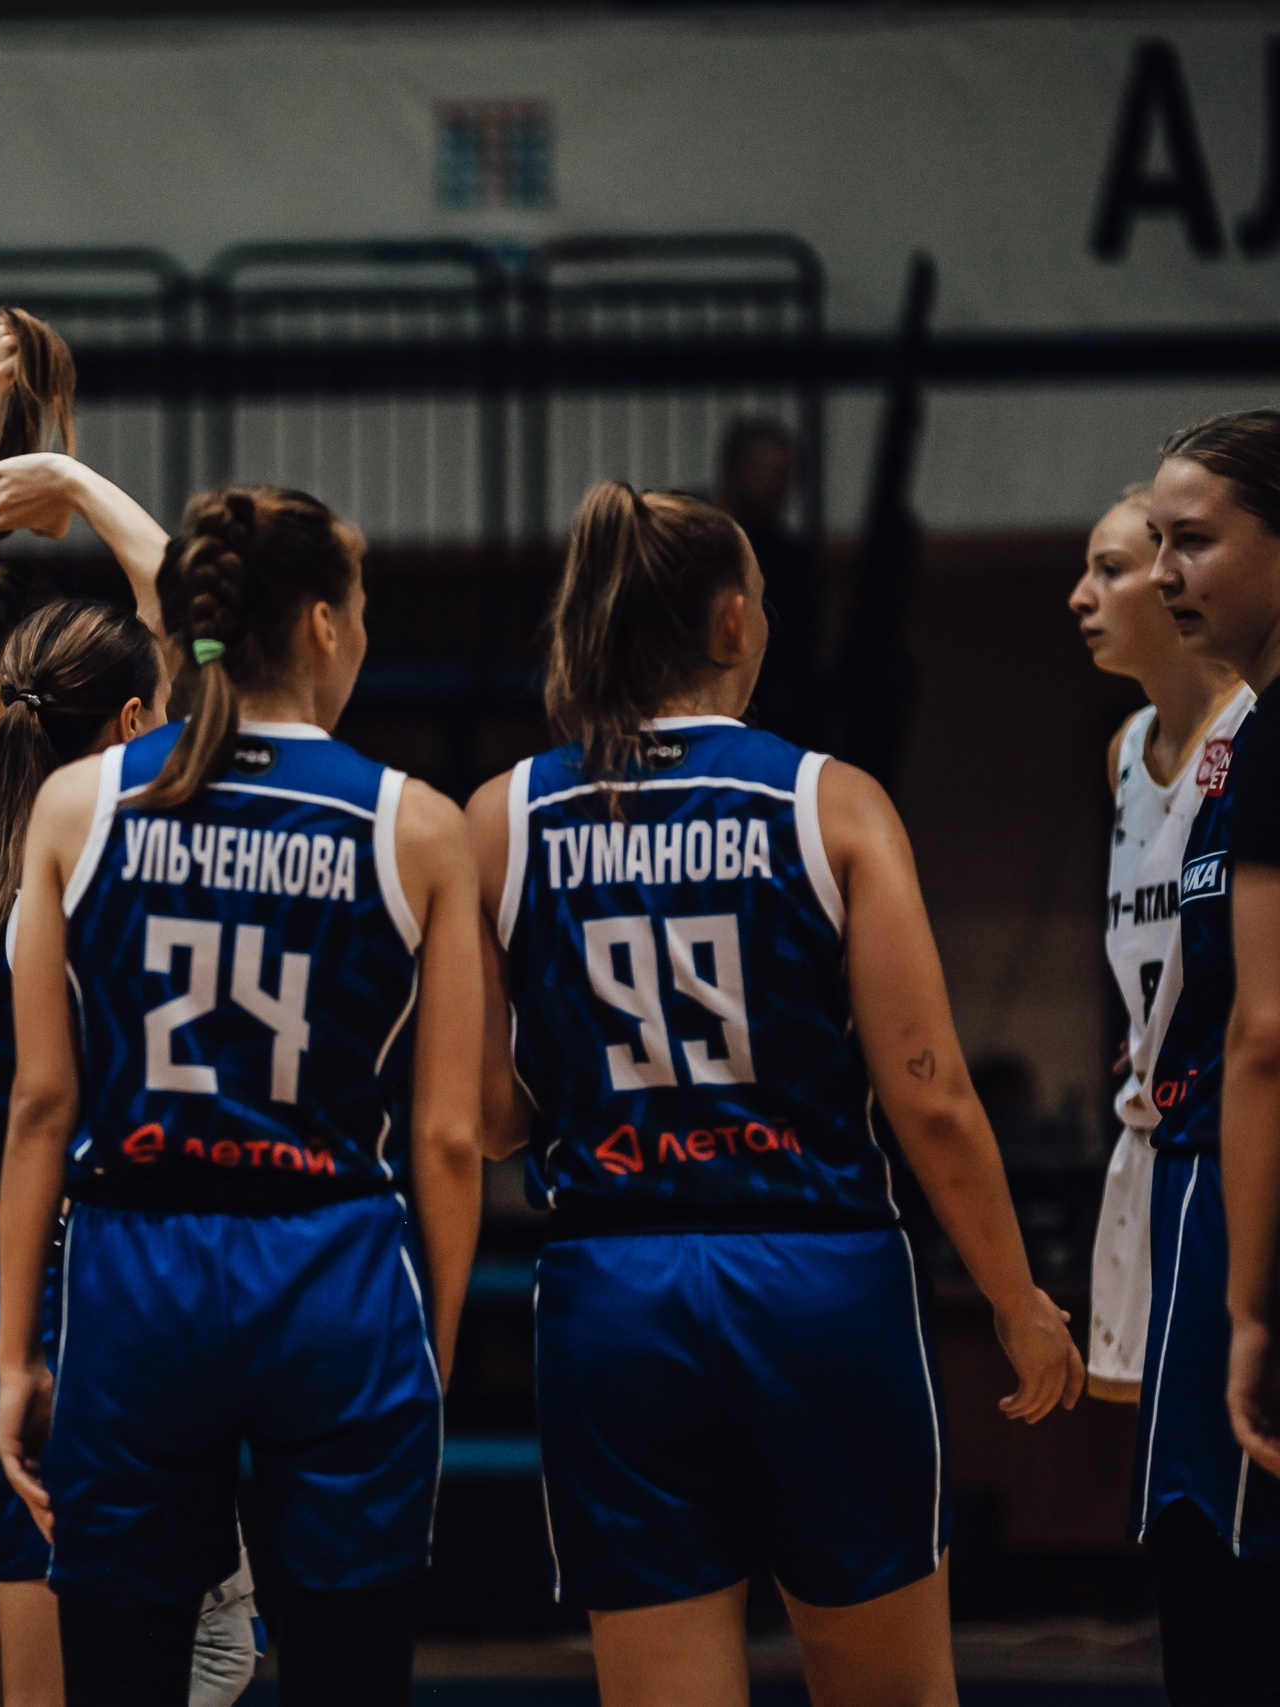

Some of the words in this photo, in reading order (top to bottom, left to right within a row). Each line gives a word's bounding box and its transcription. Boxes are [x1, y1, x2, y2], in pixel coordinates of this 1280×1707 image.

[121, 817, 357, 902] УЛЬЧЕНКОВА
[541, 816, 773, 889] ТУМАНОВА
[144, 914, 311, 1105] 24
[582, 913, 757, 1092] 99
